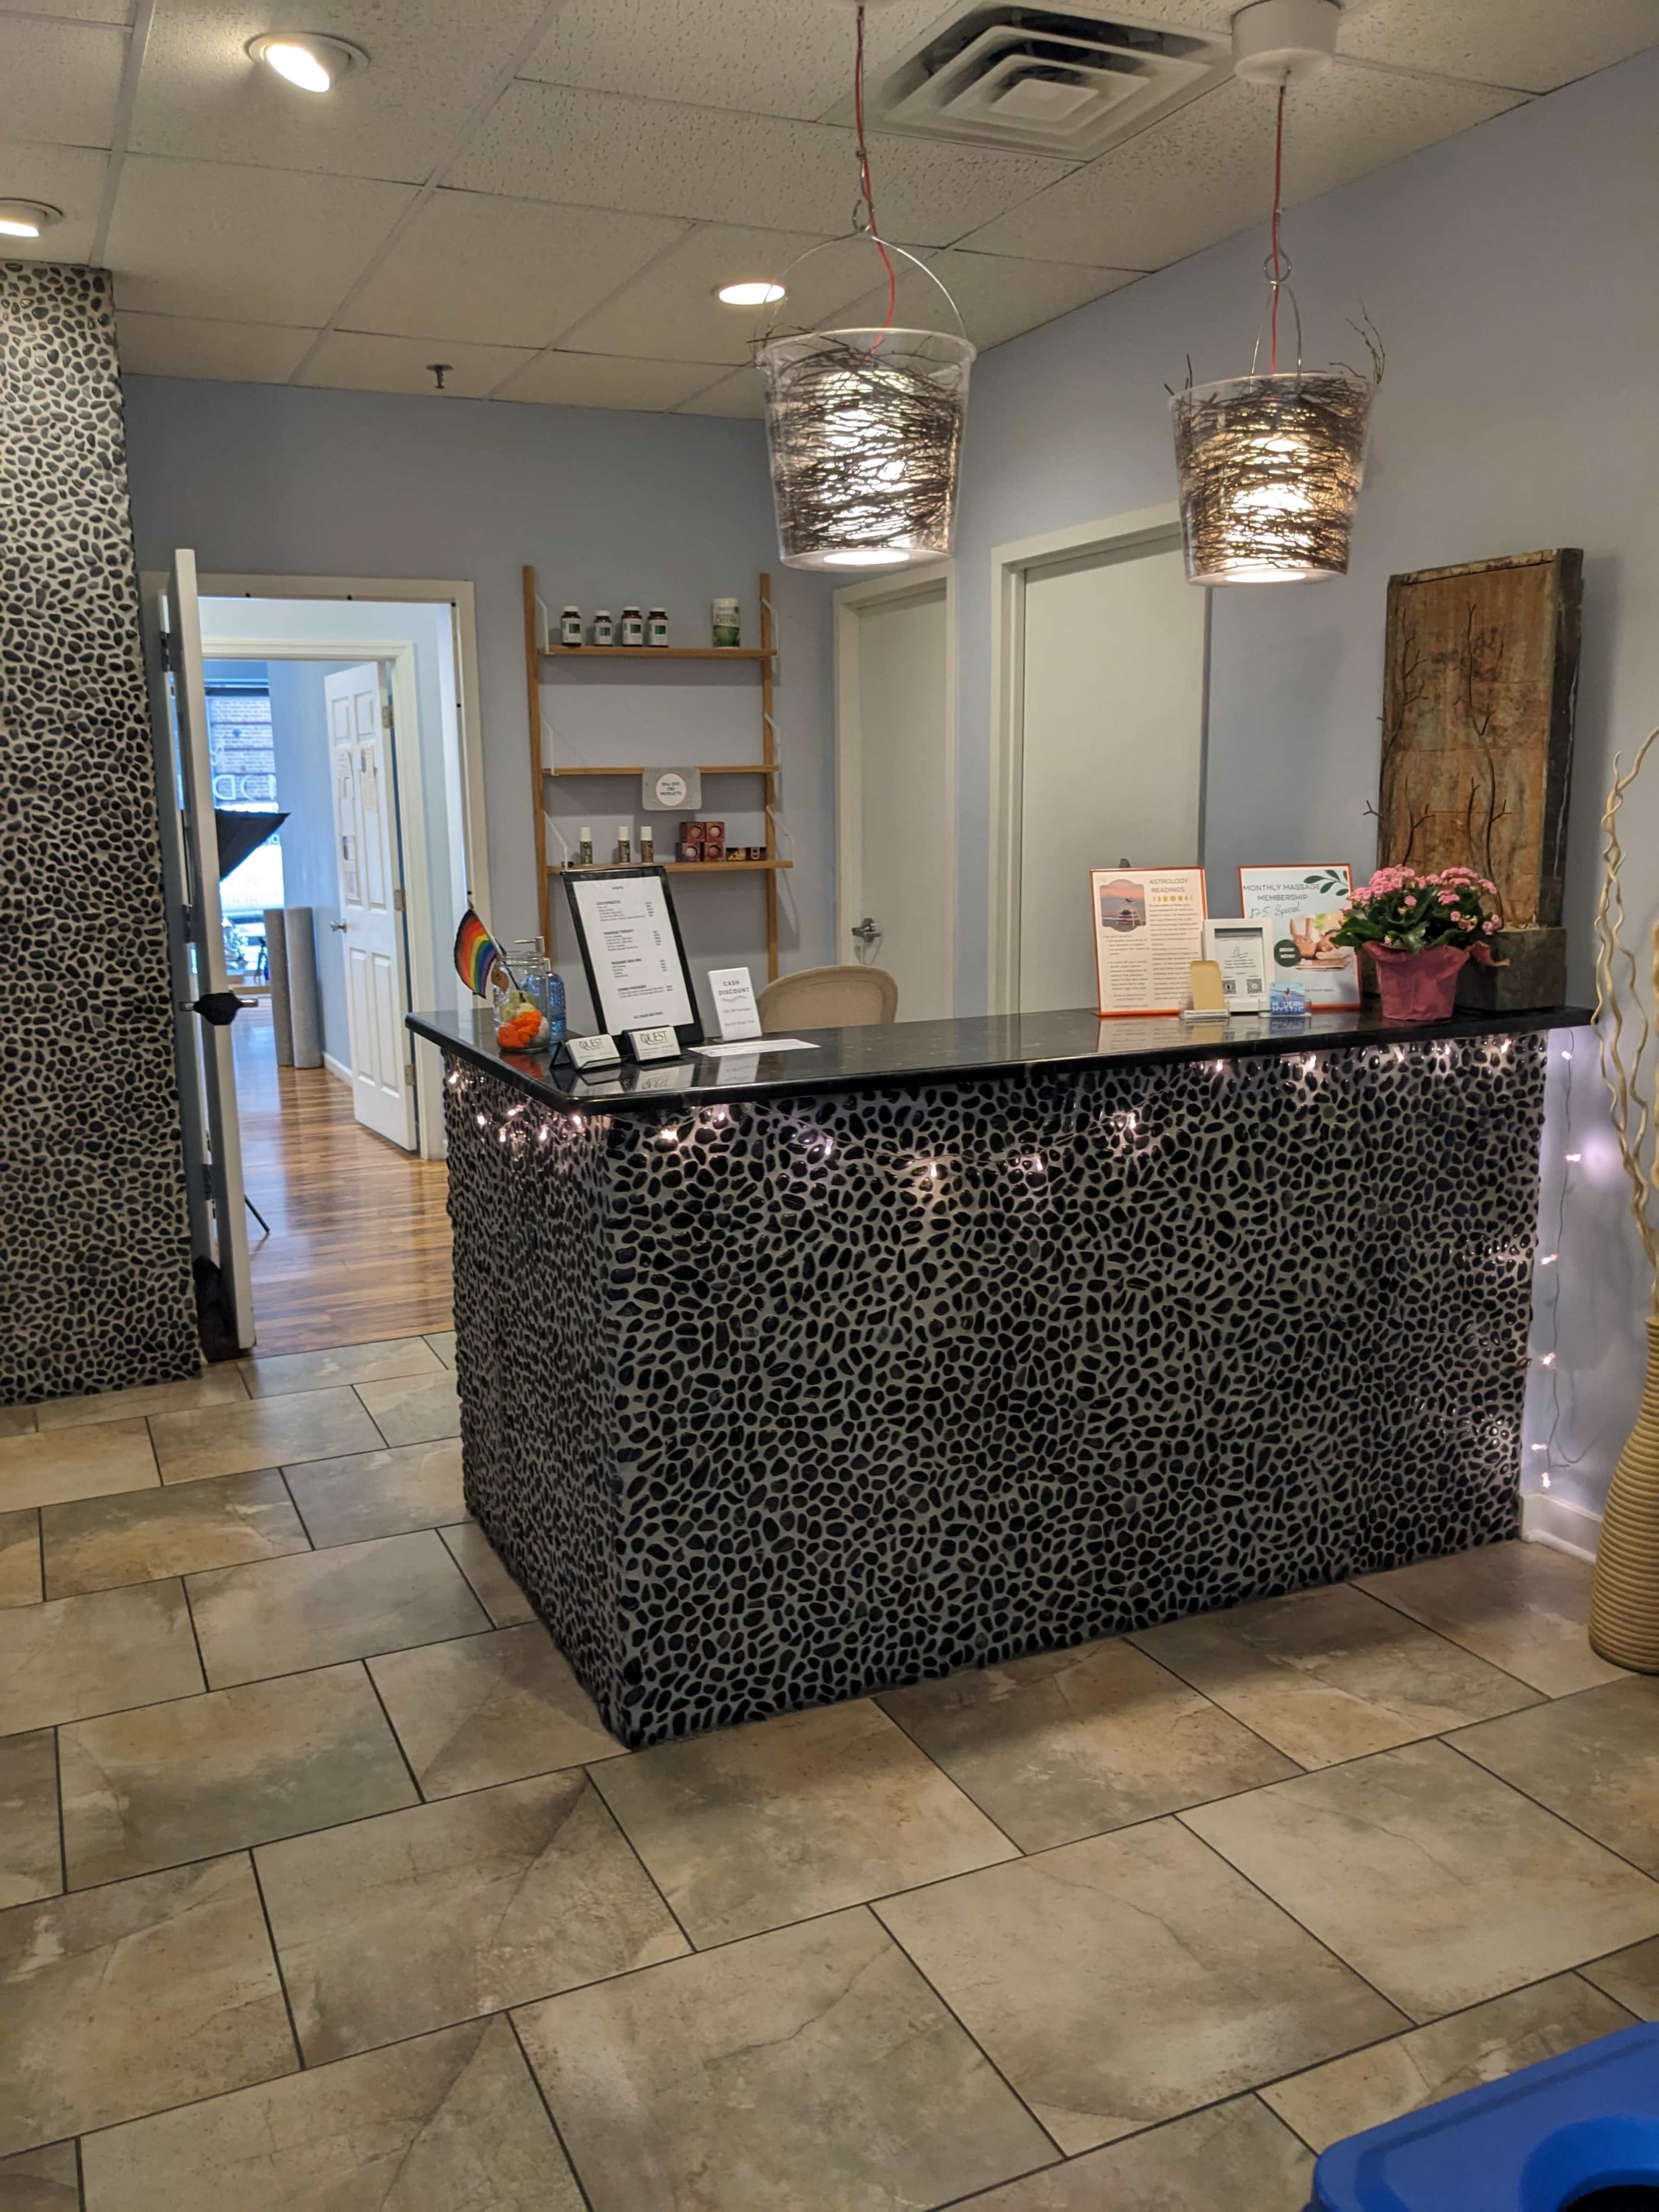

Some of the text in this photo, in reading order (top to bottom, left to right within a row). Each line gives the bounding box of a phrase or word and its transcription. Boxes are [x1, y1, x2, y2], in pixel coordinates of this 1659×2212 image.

[1274, 901, 1300, 918] Special
[718, 987, 749, 995] DISCOUNT
[578, 1038, 602, 1050] QUEST
[639, 1030, 667, 1045] QUEST
